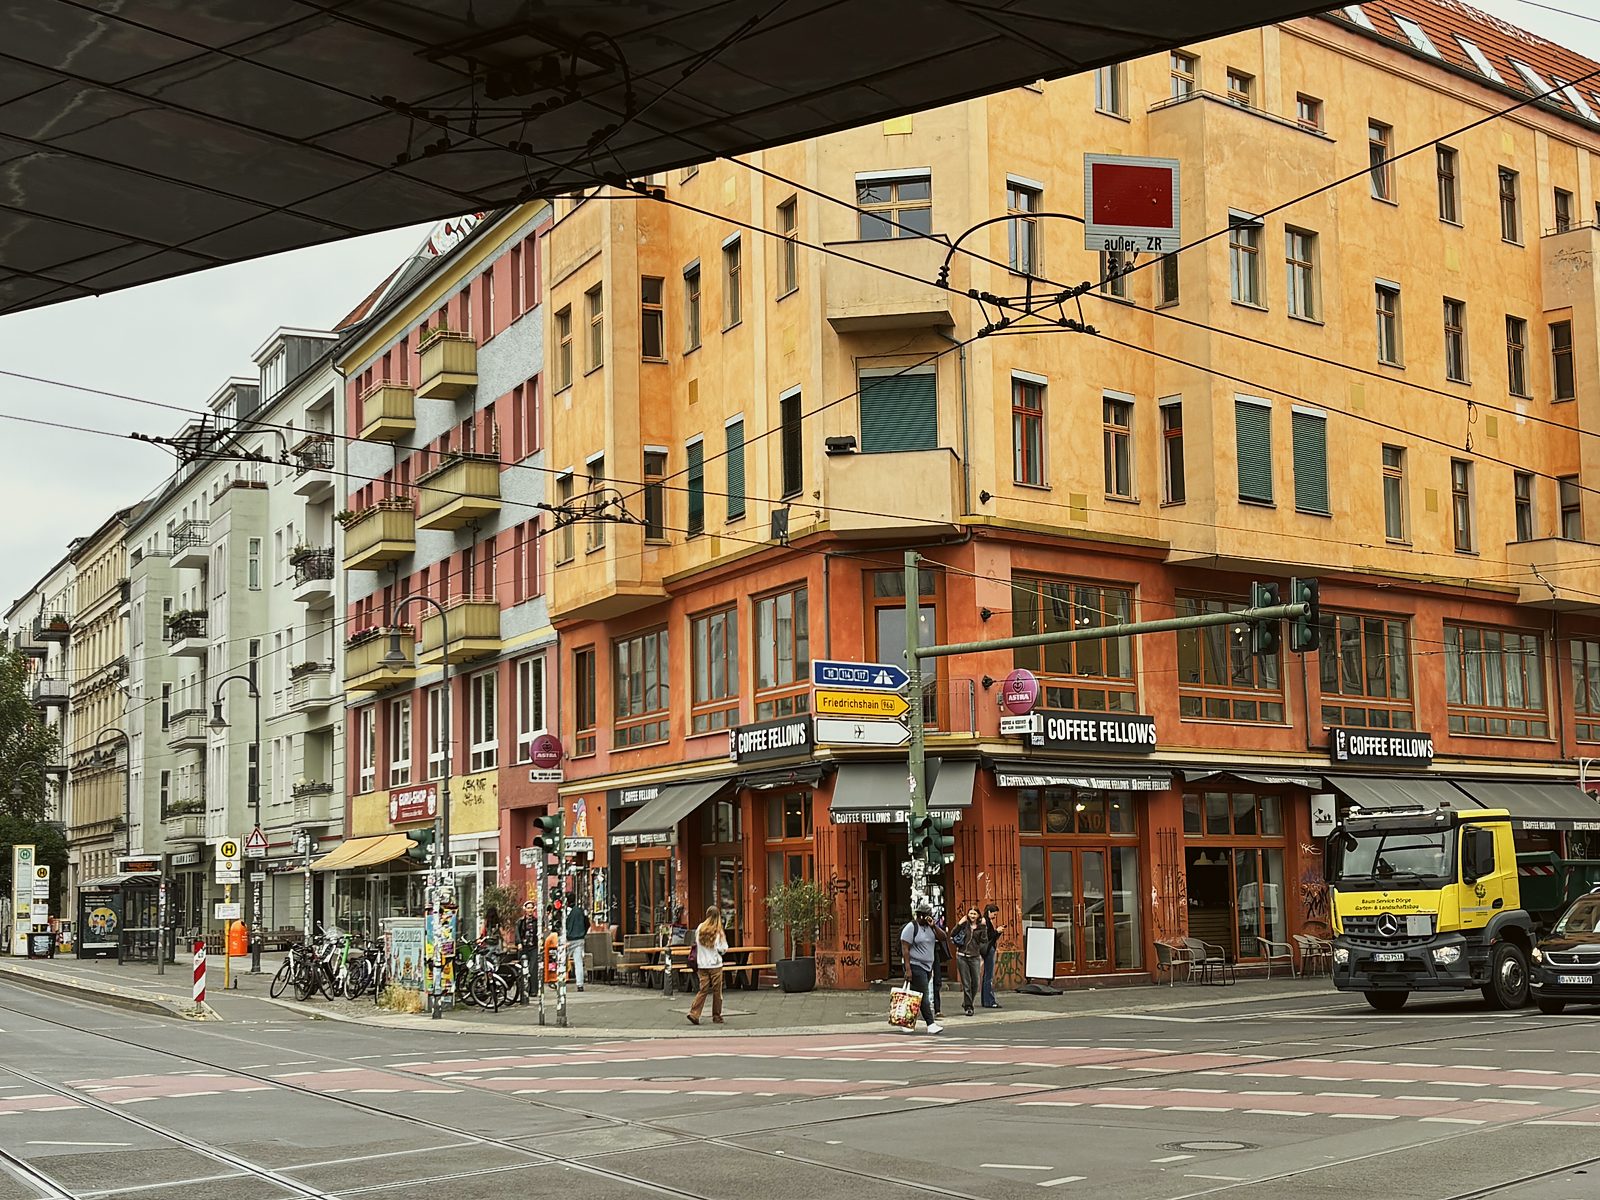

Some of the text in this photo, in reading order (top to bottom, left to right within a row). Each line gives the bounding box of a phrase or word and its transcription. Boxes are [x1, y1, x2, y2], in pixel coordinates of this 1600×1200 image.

[1146, 236, 1162, 251] ZR
[823, 697, 879, 709] Friedrichshain
[1008, 693, 1030, 702] ASTRA
[738, 722, 806, 754] COFFEE FELLOWS
[1047, 718, 1097, 742] COFFEE
[1100, 721, 1157, 745] FELLOWS
[1350, 735, 1434, 758] COFFEE FELLOWS
[836, 812, 860, 824] COFFEE
[861, 812, 891, 823] FELLOWS
